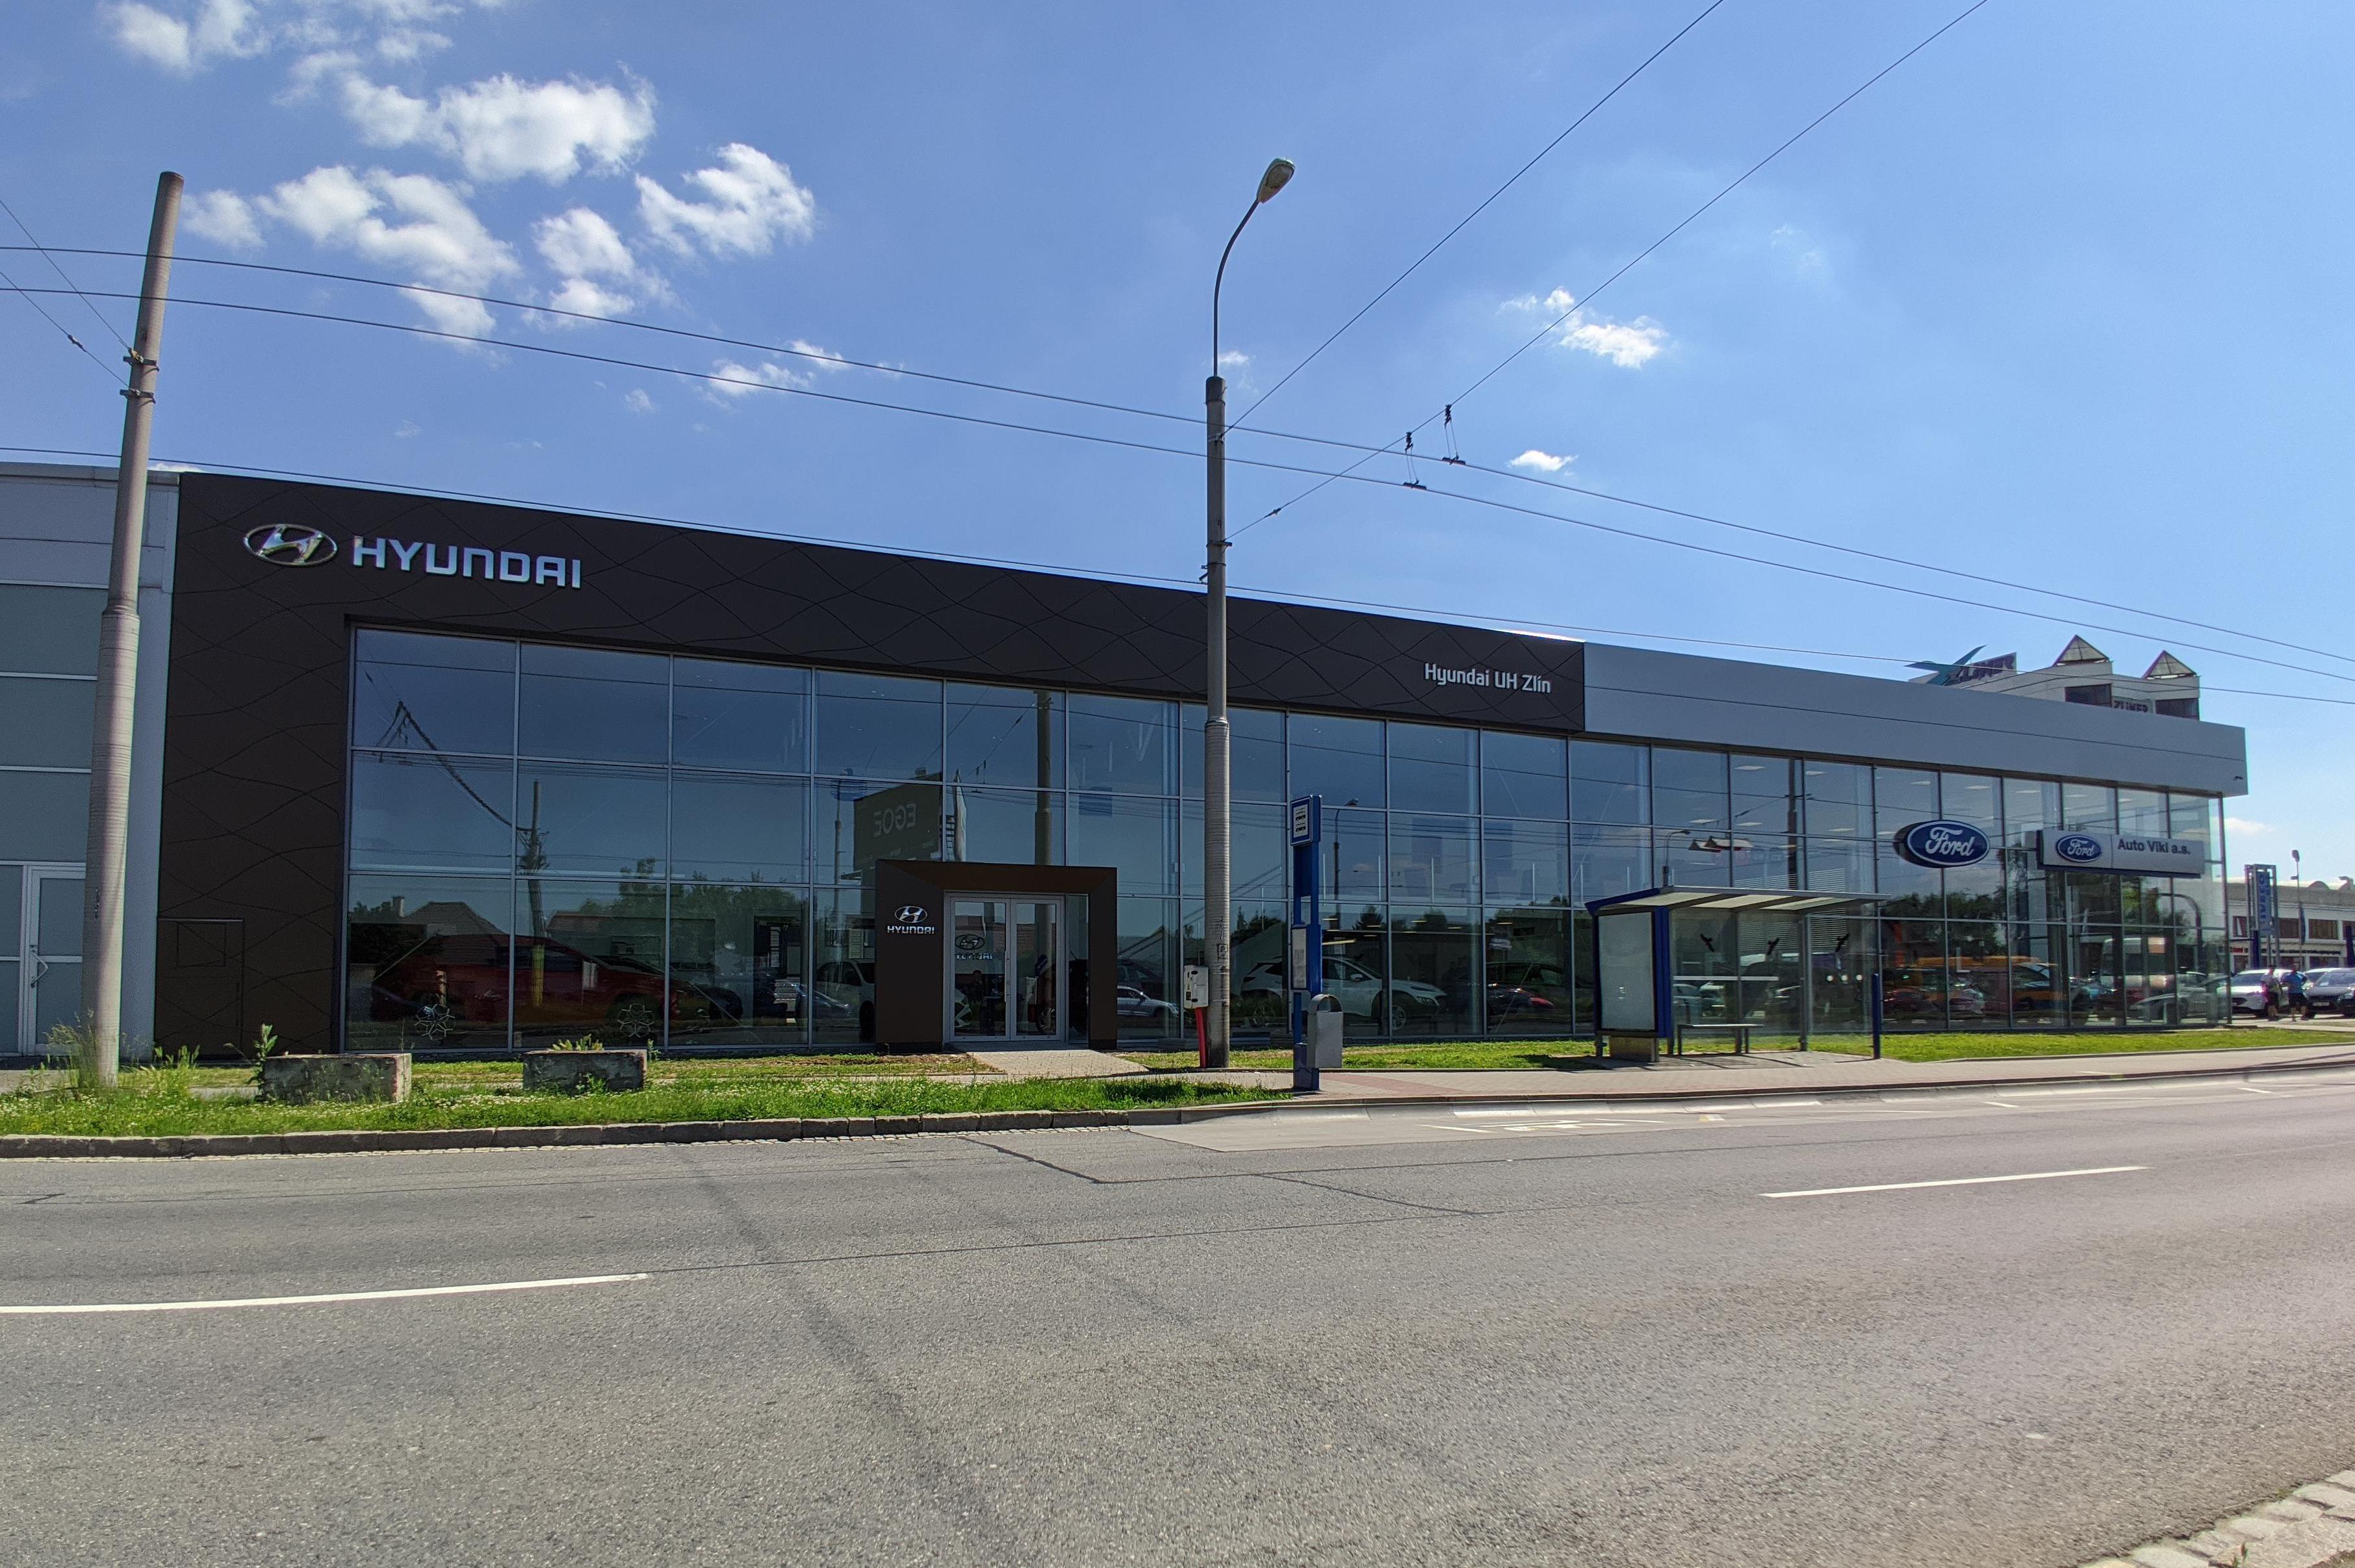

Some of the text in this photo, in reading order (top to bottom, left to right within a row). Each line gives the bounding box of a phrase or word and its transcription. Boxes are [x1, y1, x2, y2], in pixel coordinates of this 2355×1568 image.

[354, 535, 581, 589] HYUNDAI
[1425, 663, 1551, 693] Hyundai UH Zlín
[1925, 827, 1975, 856] Ford
[2067, 838, 2190, 856] Ford Auto Viki a.s.
[887, 925, 934, 934] HYUNDAI
